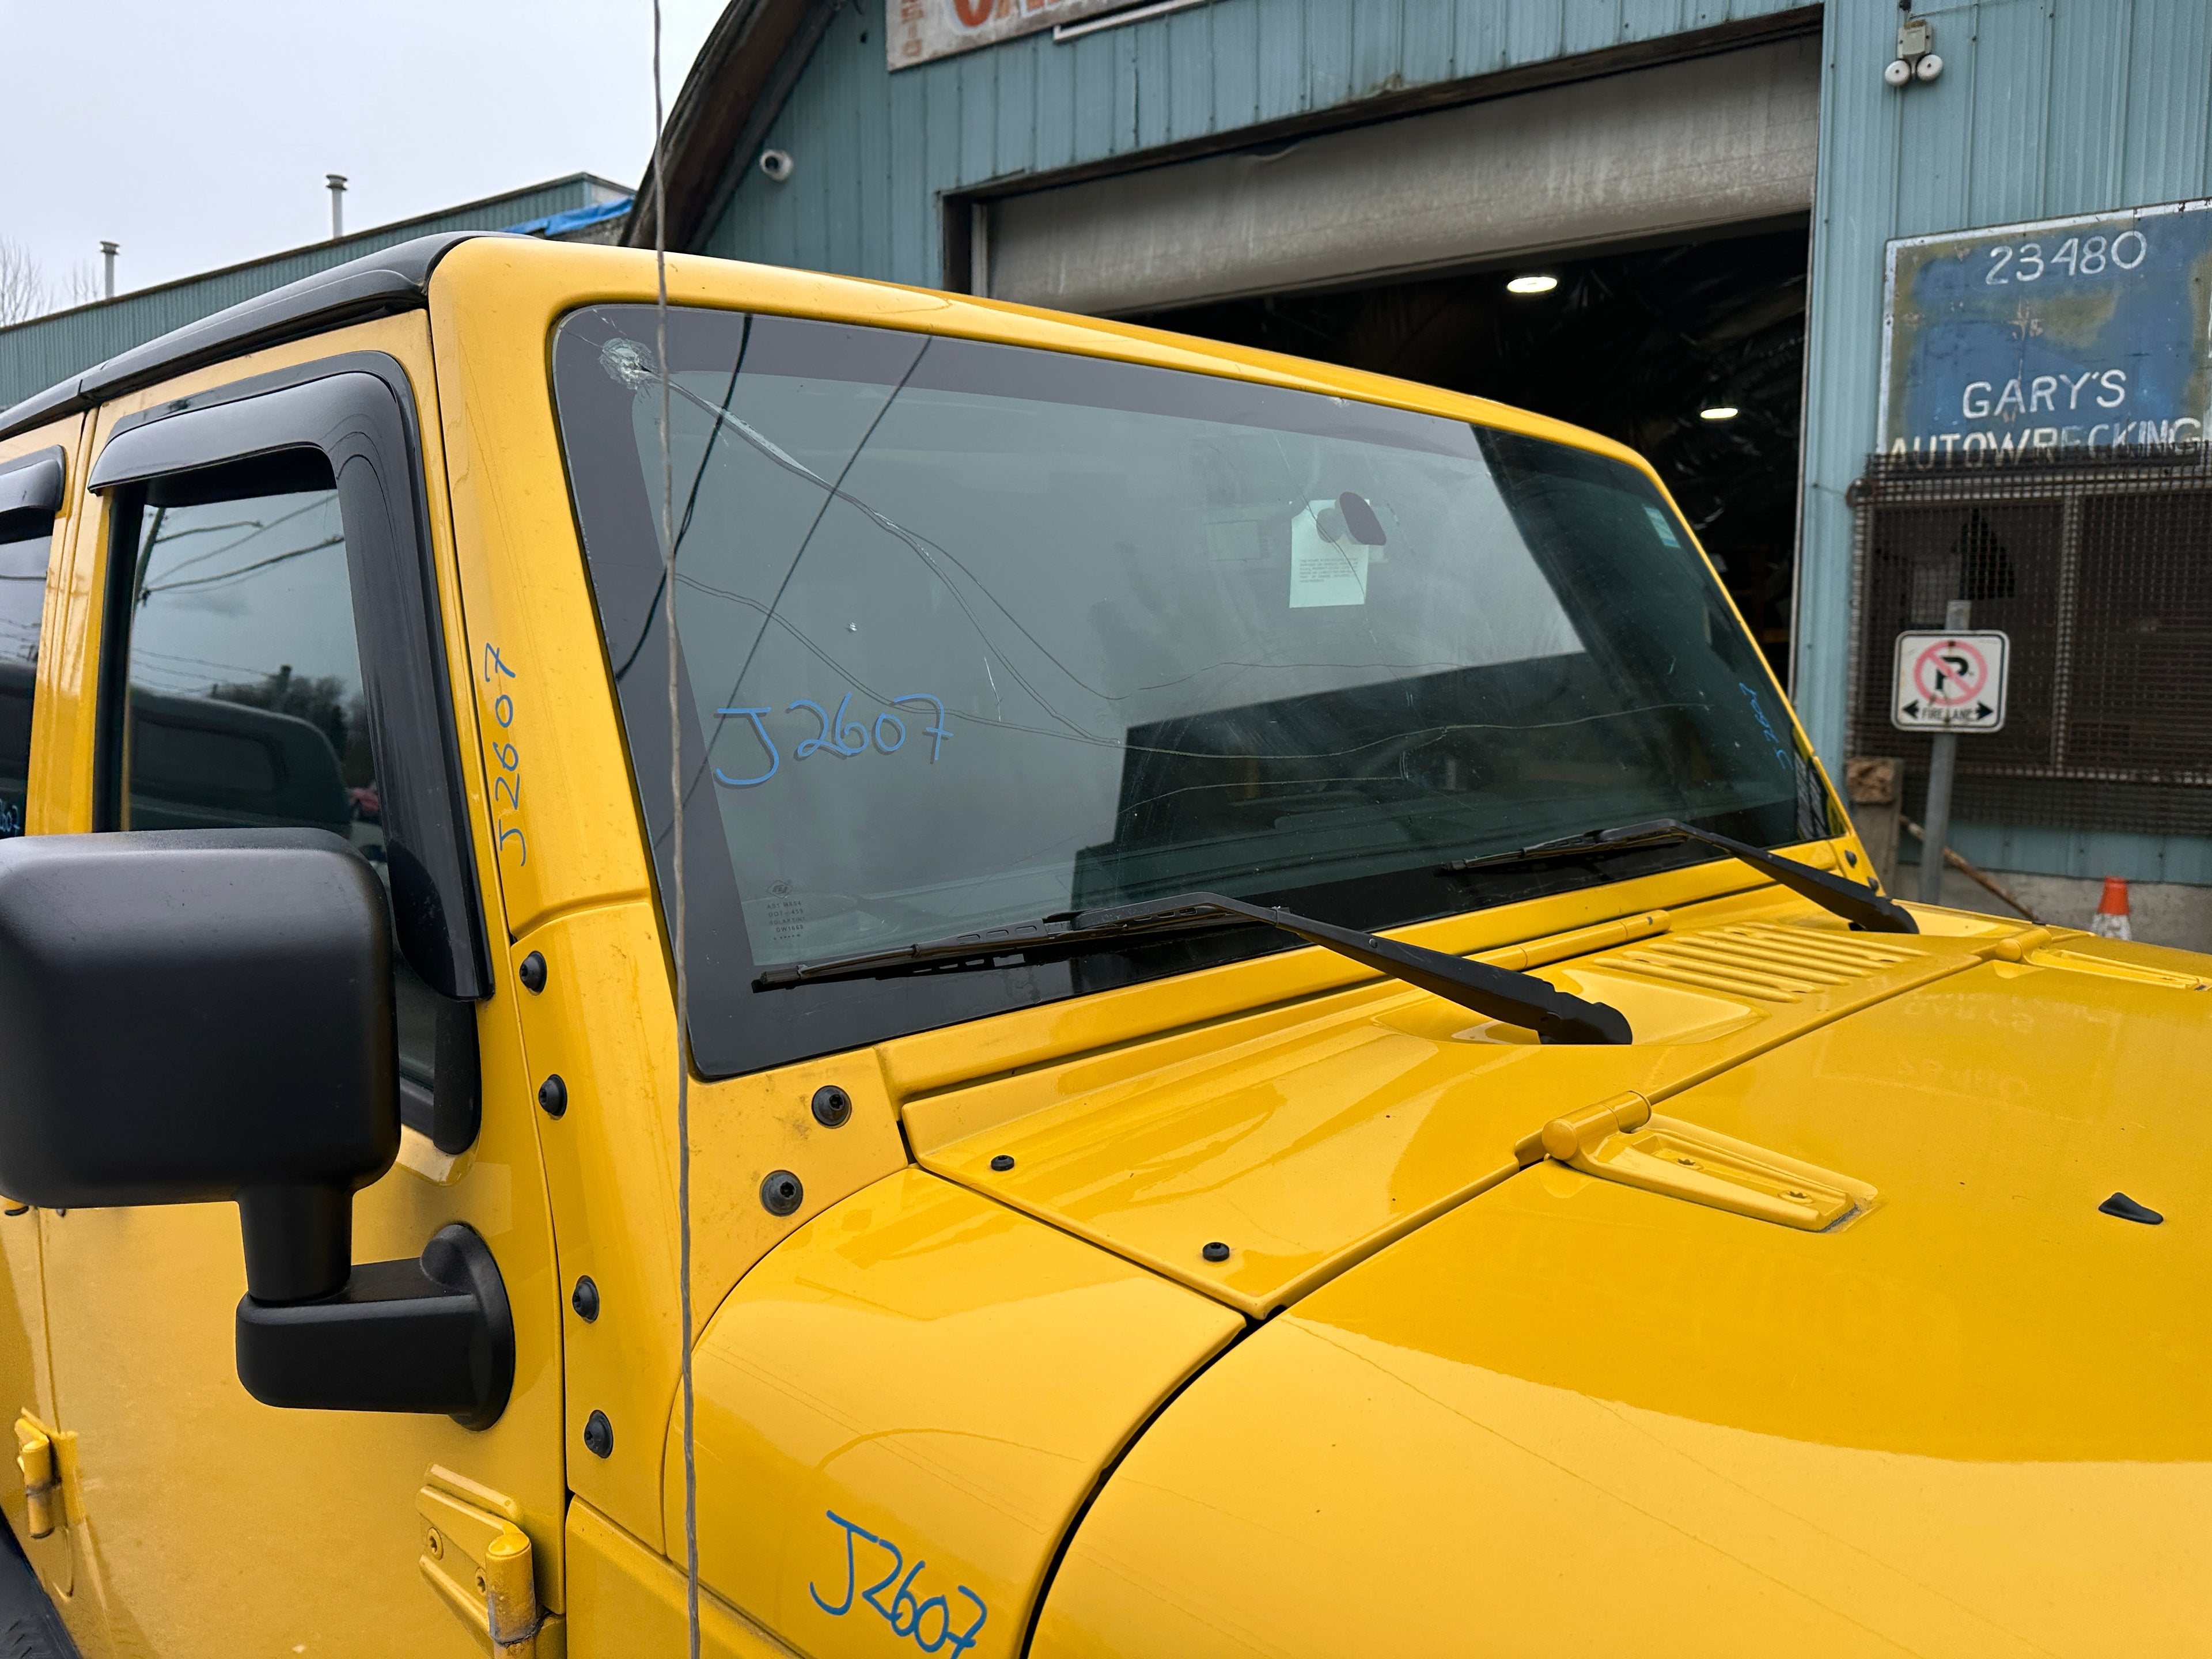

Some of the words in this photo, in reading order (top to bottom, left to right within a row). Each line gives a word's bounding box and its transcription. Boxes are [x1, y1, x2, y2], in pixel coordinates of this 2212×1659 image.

[1986, 230, 2147, 285] 23480
[1963, 369, 2127, 419] GARY'S
[484, 642, 527, 867] J2607
[716, 691, 954, 785] J2607
[809, 1509, 988, 1659] J2607
